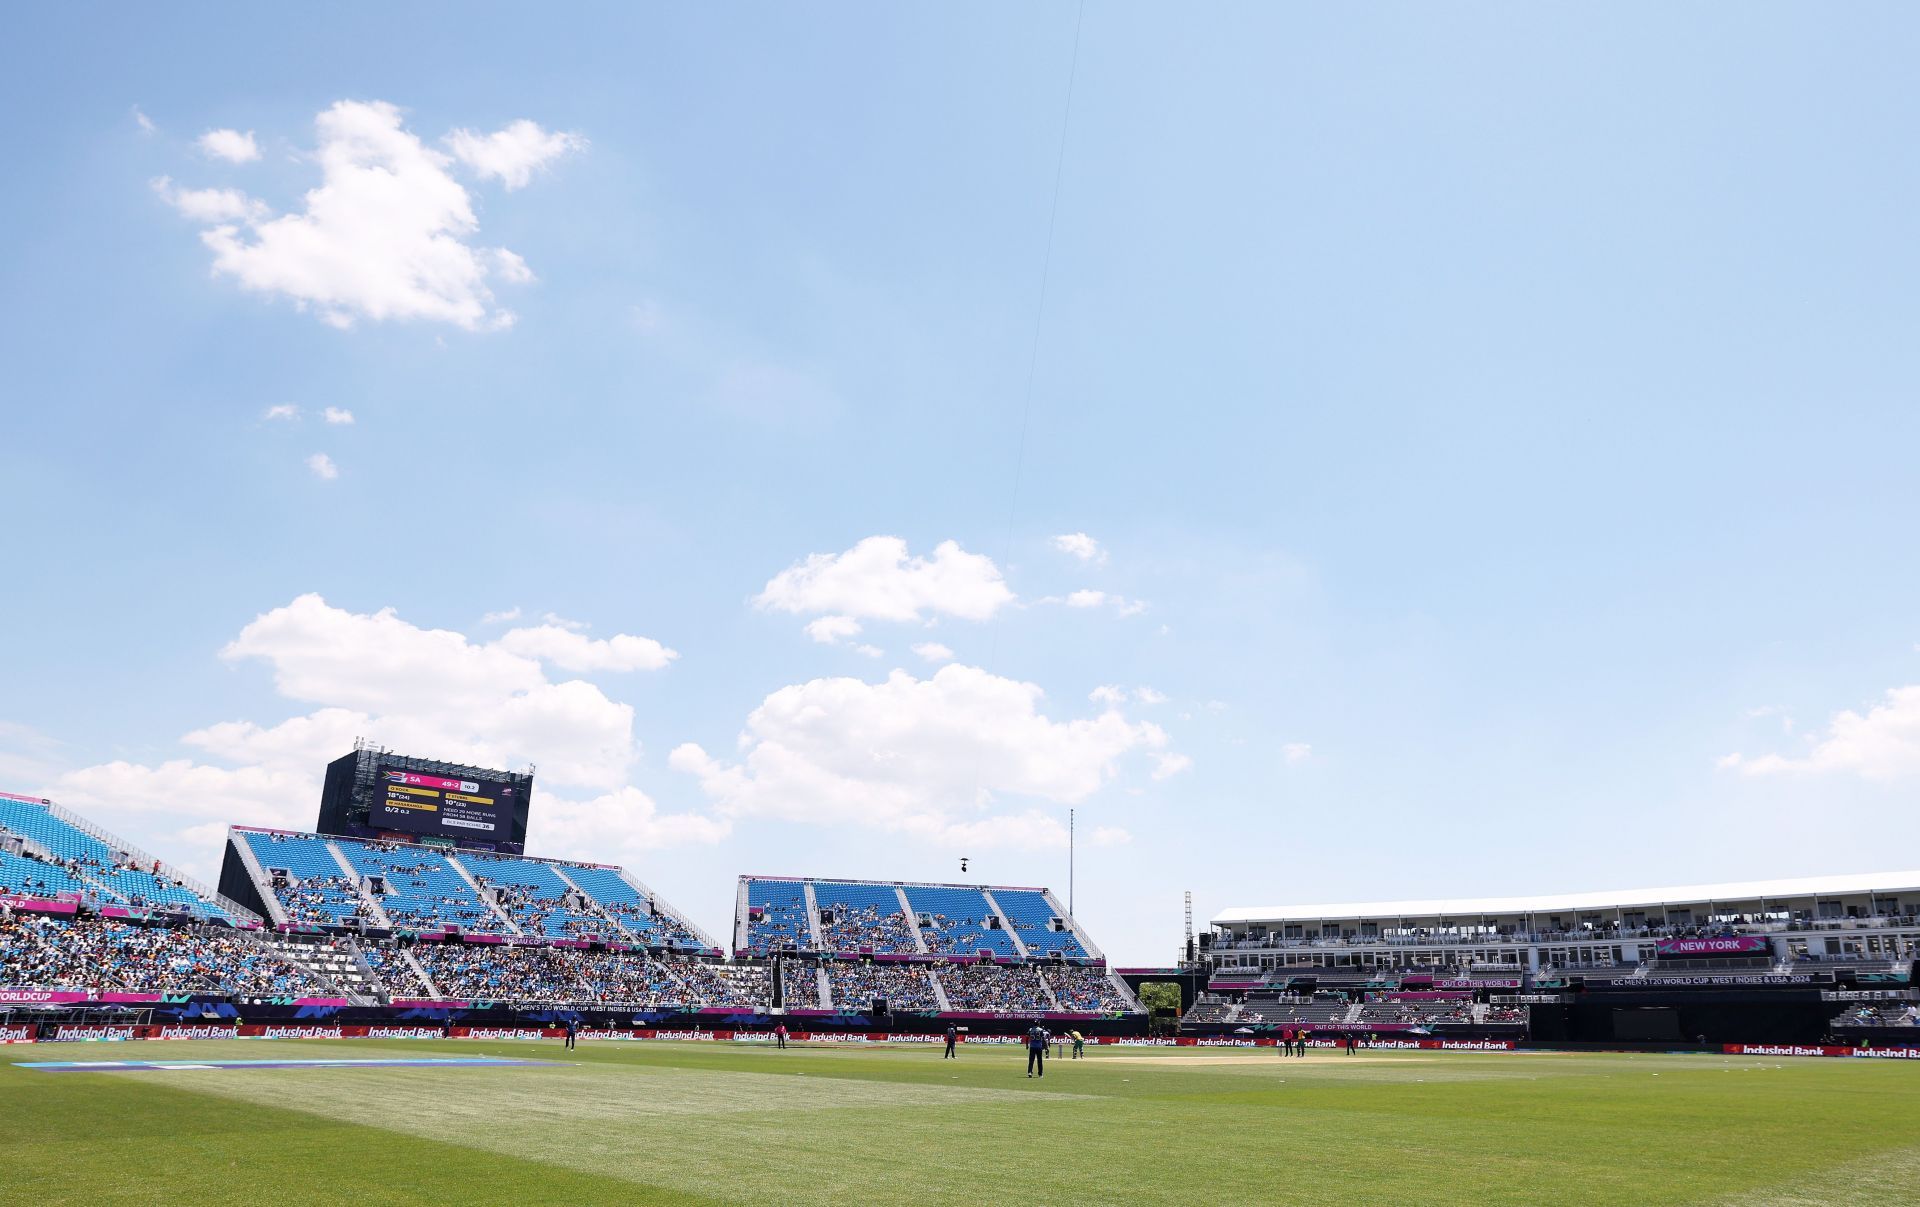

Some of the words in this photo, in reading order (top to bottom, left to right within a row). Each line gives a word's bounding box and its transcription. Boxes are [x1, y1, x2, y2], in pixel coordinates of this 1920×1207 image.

[0, 899, 25, 907] ORLD
[1680, 942, 1706, 950] NEW
[1709, 940, 1740, 950] YORK
[0, 1026, 29, 1040] Bank
[56, 1026, 107, 1039] IndusInd
[107, 1026, 135, 1038] Bank
[160, 1026, 211, 1038] IndusInd
[211, 1027, 239, 1038] Bank
[265, 1026, 315, 1037] IndusInd
[315, 1027, 342, 1037] Bank
[368, 1027, 417, 1037] IndusInd
[417, 1028, 444, 1037] Bank
[469, 1028, 516, 1038] IndusInd
[516, 1029, 542, 1038] Bank
[576, 1030, 610, 1038] dusInd
[611, 1030, 634, 1039] Bank
[656, 1031, 693, 1039] IndusInd
[693, 1032, 714, 1040] Bank
[1743, 1045, 1792, 1054] IndusInd
[1794, 1047, 1824, 1056] Bank
[1853, 1048, 1906, 1057] IndusInd
